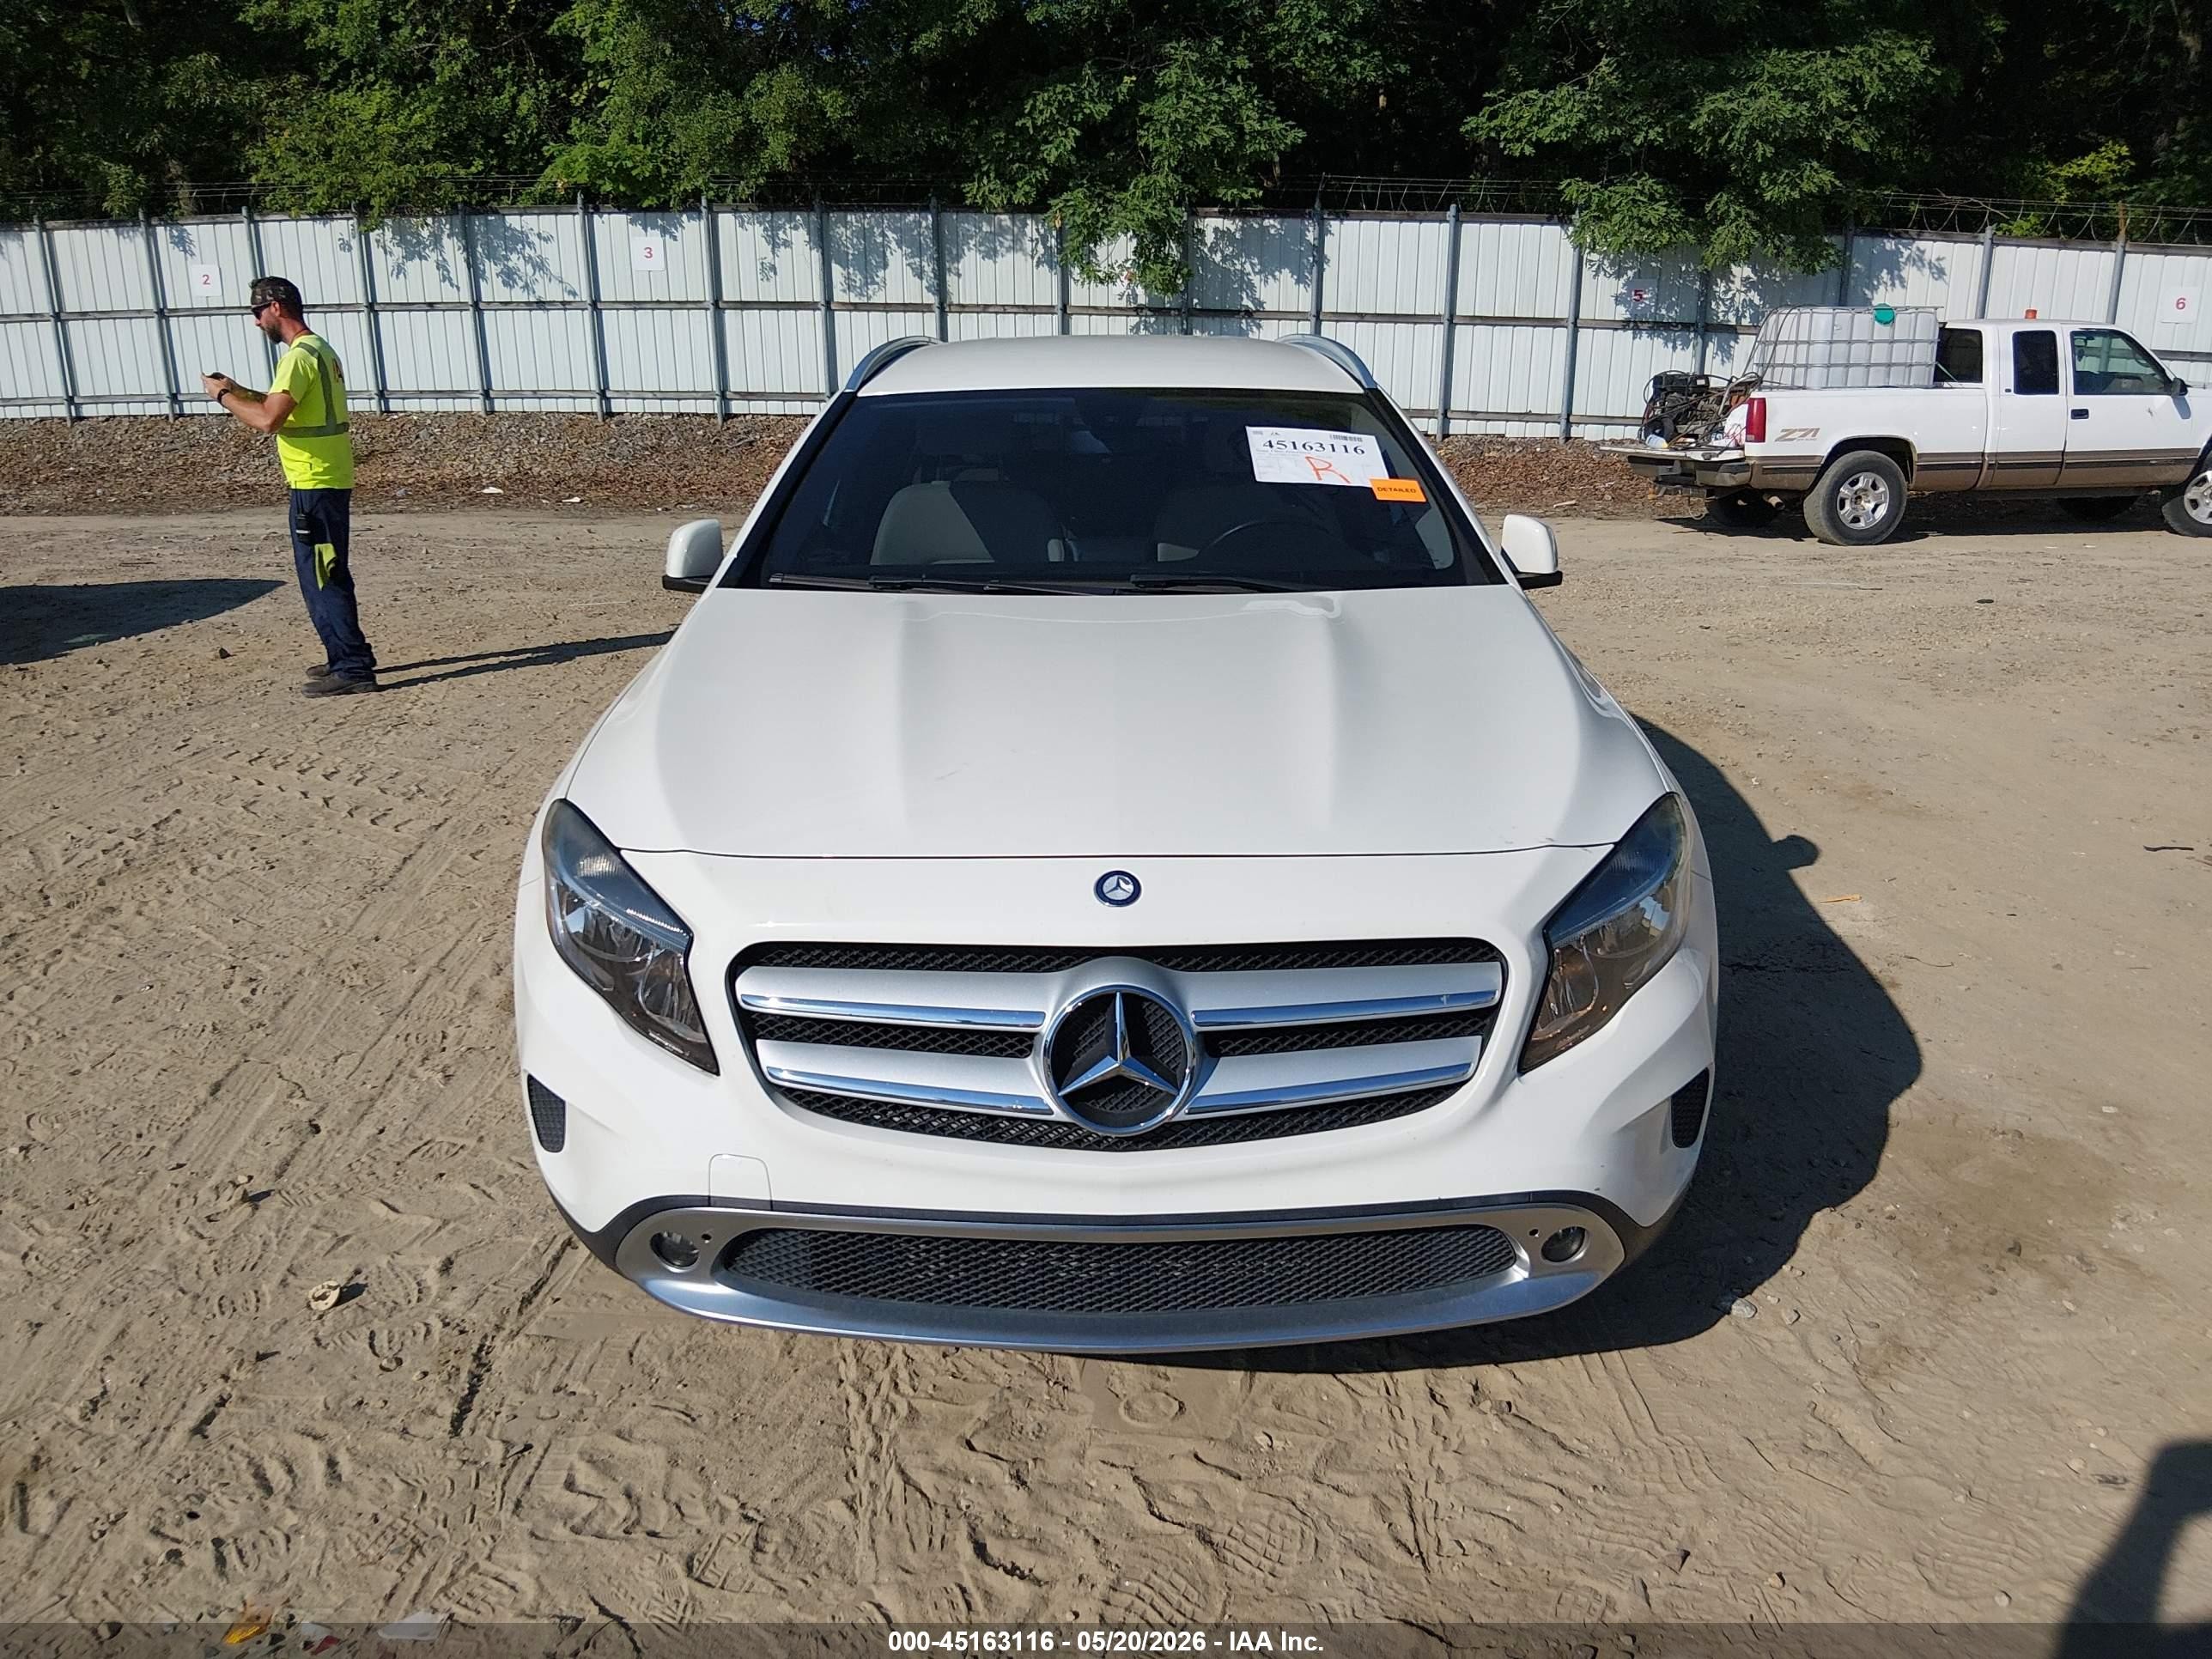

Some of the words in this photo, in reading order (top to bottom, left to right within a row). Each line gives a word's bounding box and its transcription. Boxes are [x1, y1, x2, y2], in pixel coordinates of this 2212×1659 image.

[644, 246, 653, 258] 3
[202, 274, 211, 285] 2
[1632, 289, 1644, 302] 5
[2176, 297, 2186, 310] 6
[1774, 428, 1820, 442] Z71
[1262, 439, 1365, 456] 45163116
[1304, 455, 1351, 484] R
